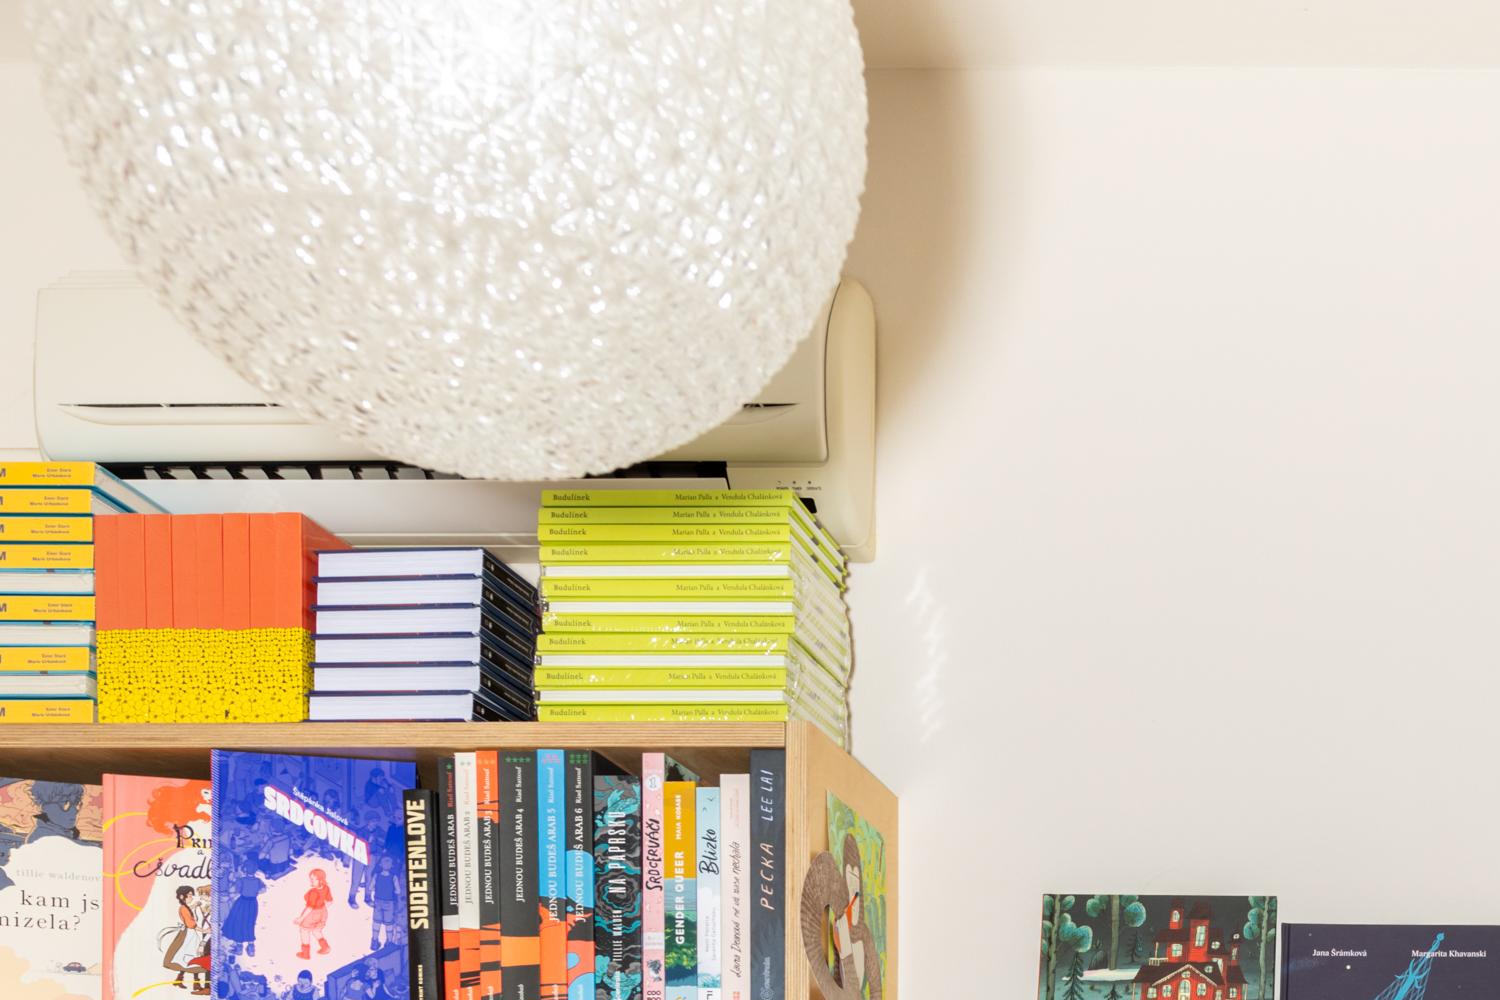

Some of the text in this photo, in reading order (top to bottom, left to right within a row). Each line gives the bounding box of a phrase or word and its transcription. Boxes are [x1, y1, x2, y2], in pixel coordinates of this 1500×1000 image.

[553, 493, 590, 501] Budulínek
[263, 785, 371, 865] SRDCOVKA
[410, 798, 430, 929] SUDETENLOVE
[608, 811, 627, 894] NA PAPRSKU
[760, 769, 775, 910] PECKA LEE LAI
[674, 851, 686, 945] GENDER QUEER
[1331, 948, 1367, 957] Šrámková
[1411, 950, 1447, 958] Margarita
